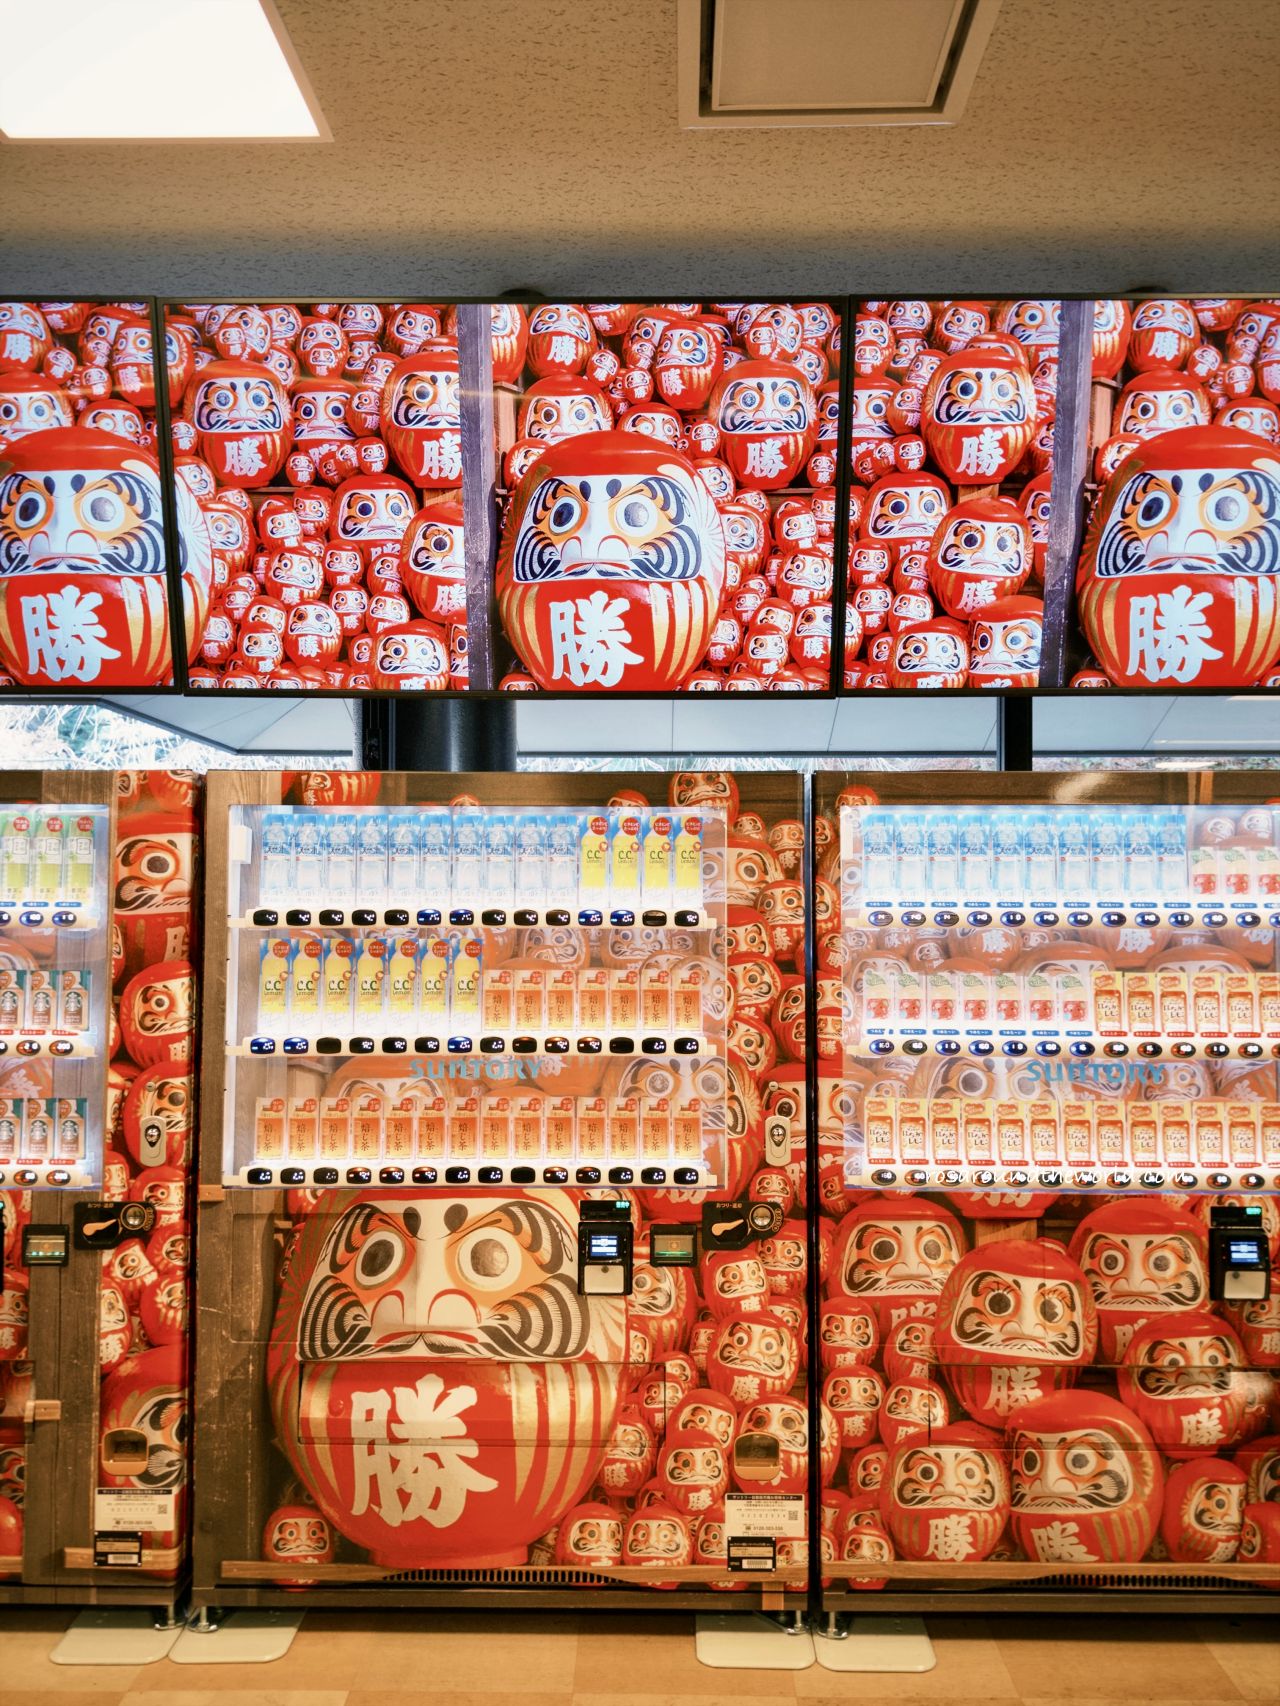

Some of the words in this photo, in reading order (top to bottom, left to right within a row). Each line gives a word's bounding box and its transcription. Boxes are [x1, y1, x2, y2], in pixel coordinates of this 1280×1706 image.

[224, 436, 266, 477] 勝
[744, 438, 788, 478] 勝
[956, 427, 1005, 476] 勝
[20, 585, 121, 683] 勝
[550, 590, 643, 686] 勝
[1126, 585, 1223, 683] 勝
[265, 980, 283, 991] C.C.
[297, 980, 315, 991] C.C.
[329, 980, 347, 991] C.C.
[361, 980, 379, 991] C.C.
[394, 980, 412, 991] C.C.
[425, 980, 443, 991] C.C.
[458, 980, 476, 991] C.C.
[351, 1373, 499, 1528] 勝
[924, 1514, 976, 1562] 勝
